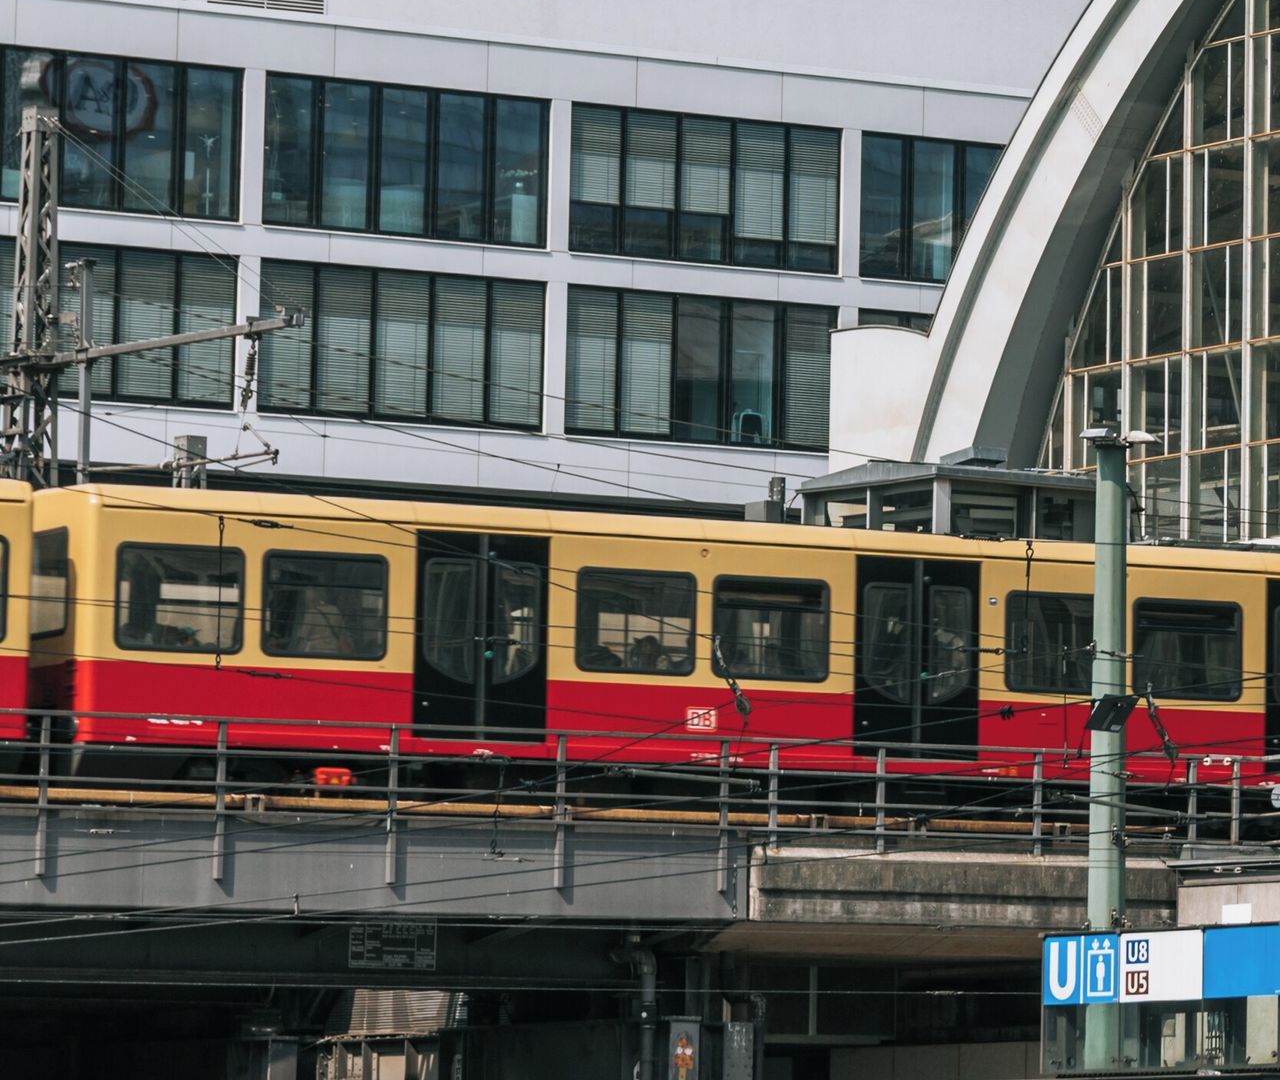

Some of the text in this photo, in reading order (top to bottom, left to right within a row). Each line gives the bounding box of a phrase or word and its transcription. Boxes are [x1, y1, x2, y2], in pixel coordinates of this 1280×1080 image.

[690, 710, 713, 728] DB
[1128, 941, 1147, 962] U8
[1050, 941, 1077, 1000] U
[1127, 972, 1147, 993] U5
